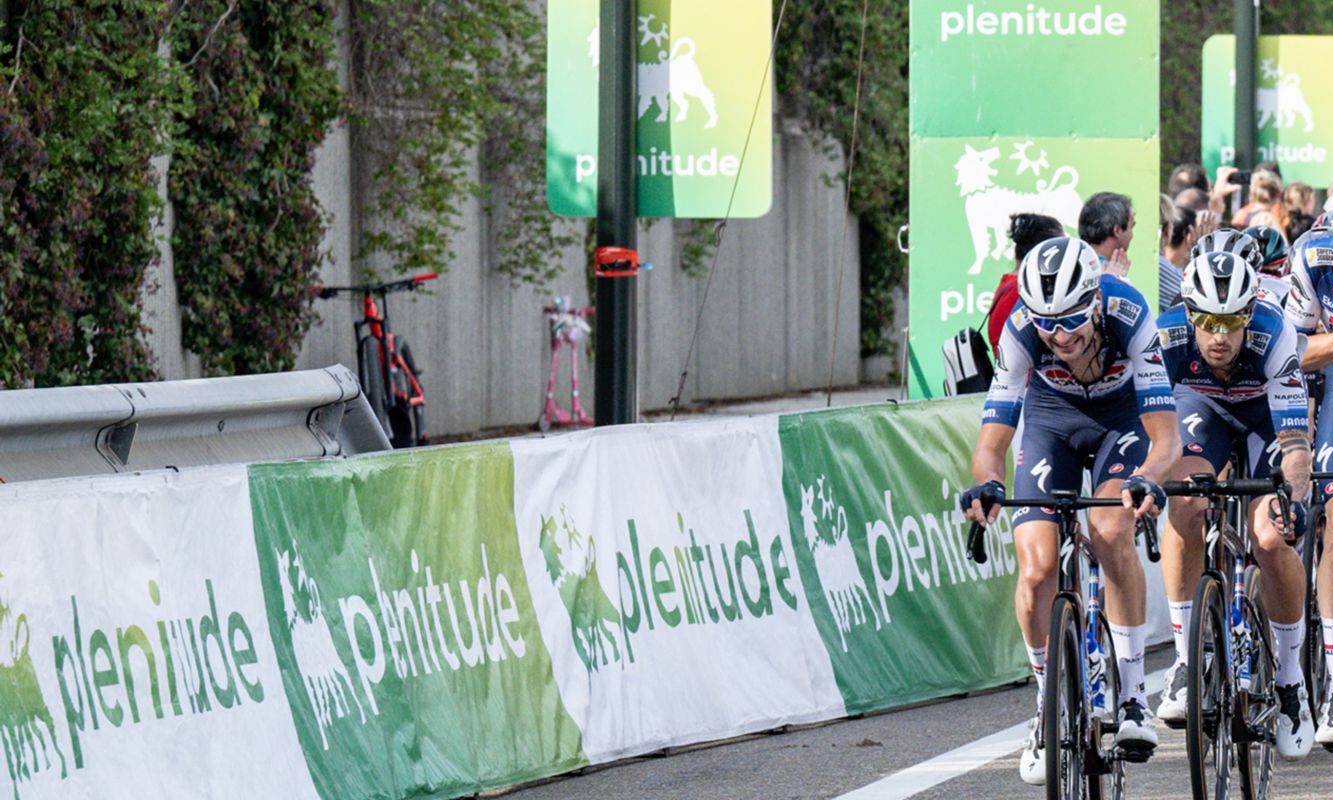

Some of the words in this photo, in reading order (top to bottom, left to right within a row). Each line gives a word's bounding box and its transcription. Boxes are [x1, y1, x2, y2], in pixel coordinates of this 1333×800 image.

[941, 4, 1127, 41] plenitude
[575, 147, 741, 183] pnitude
[1220, 141, 1327, 165] pnitude
[338, 542, 525, 716] plenitude
